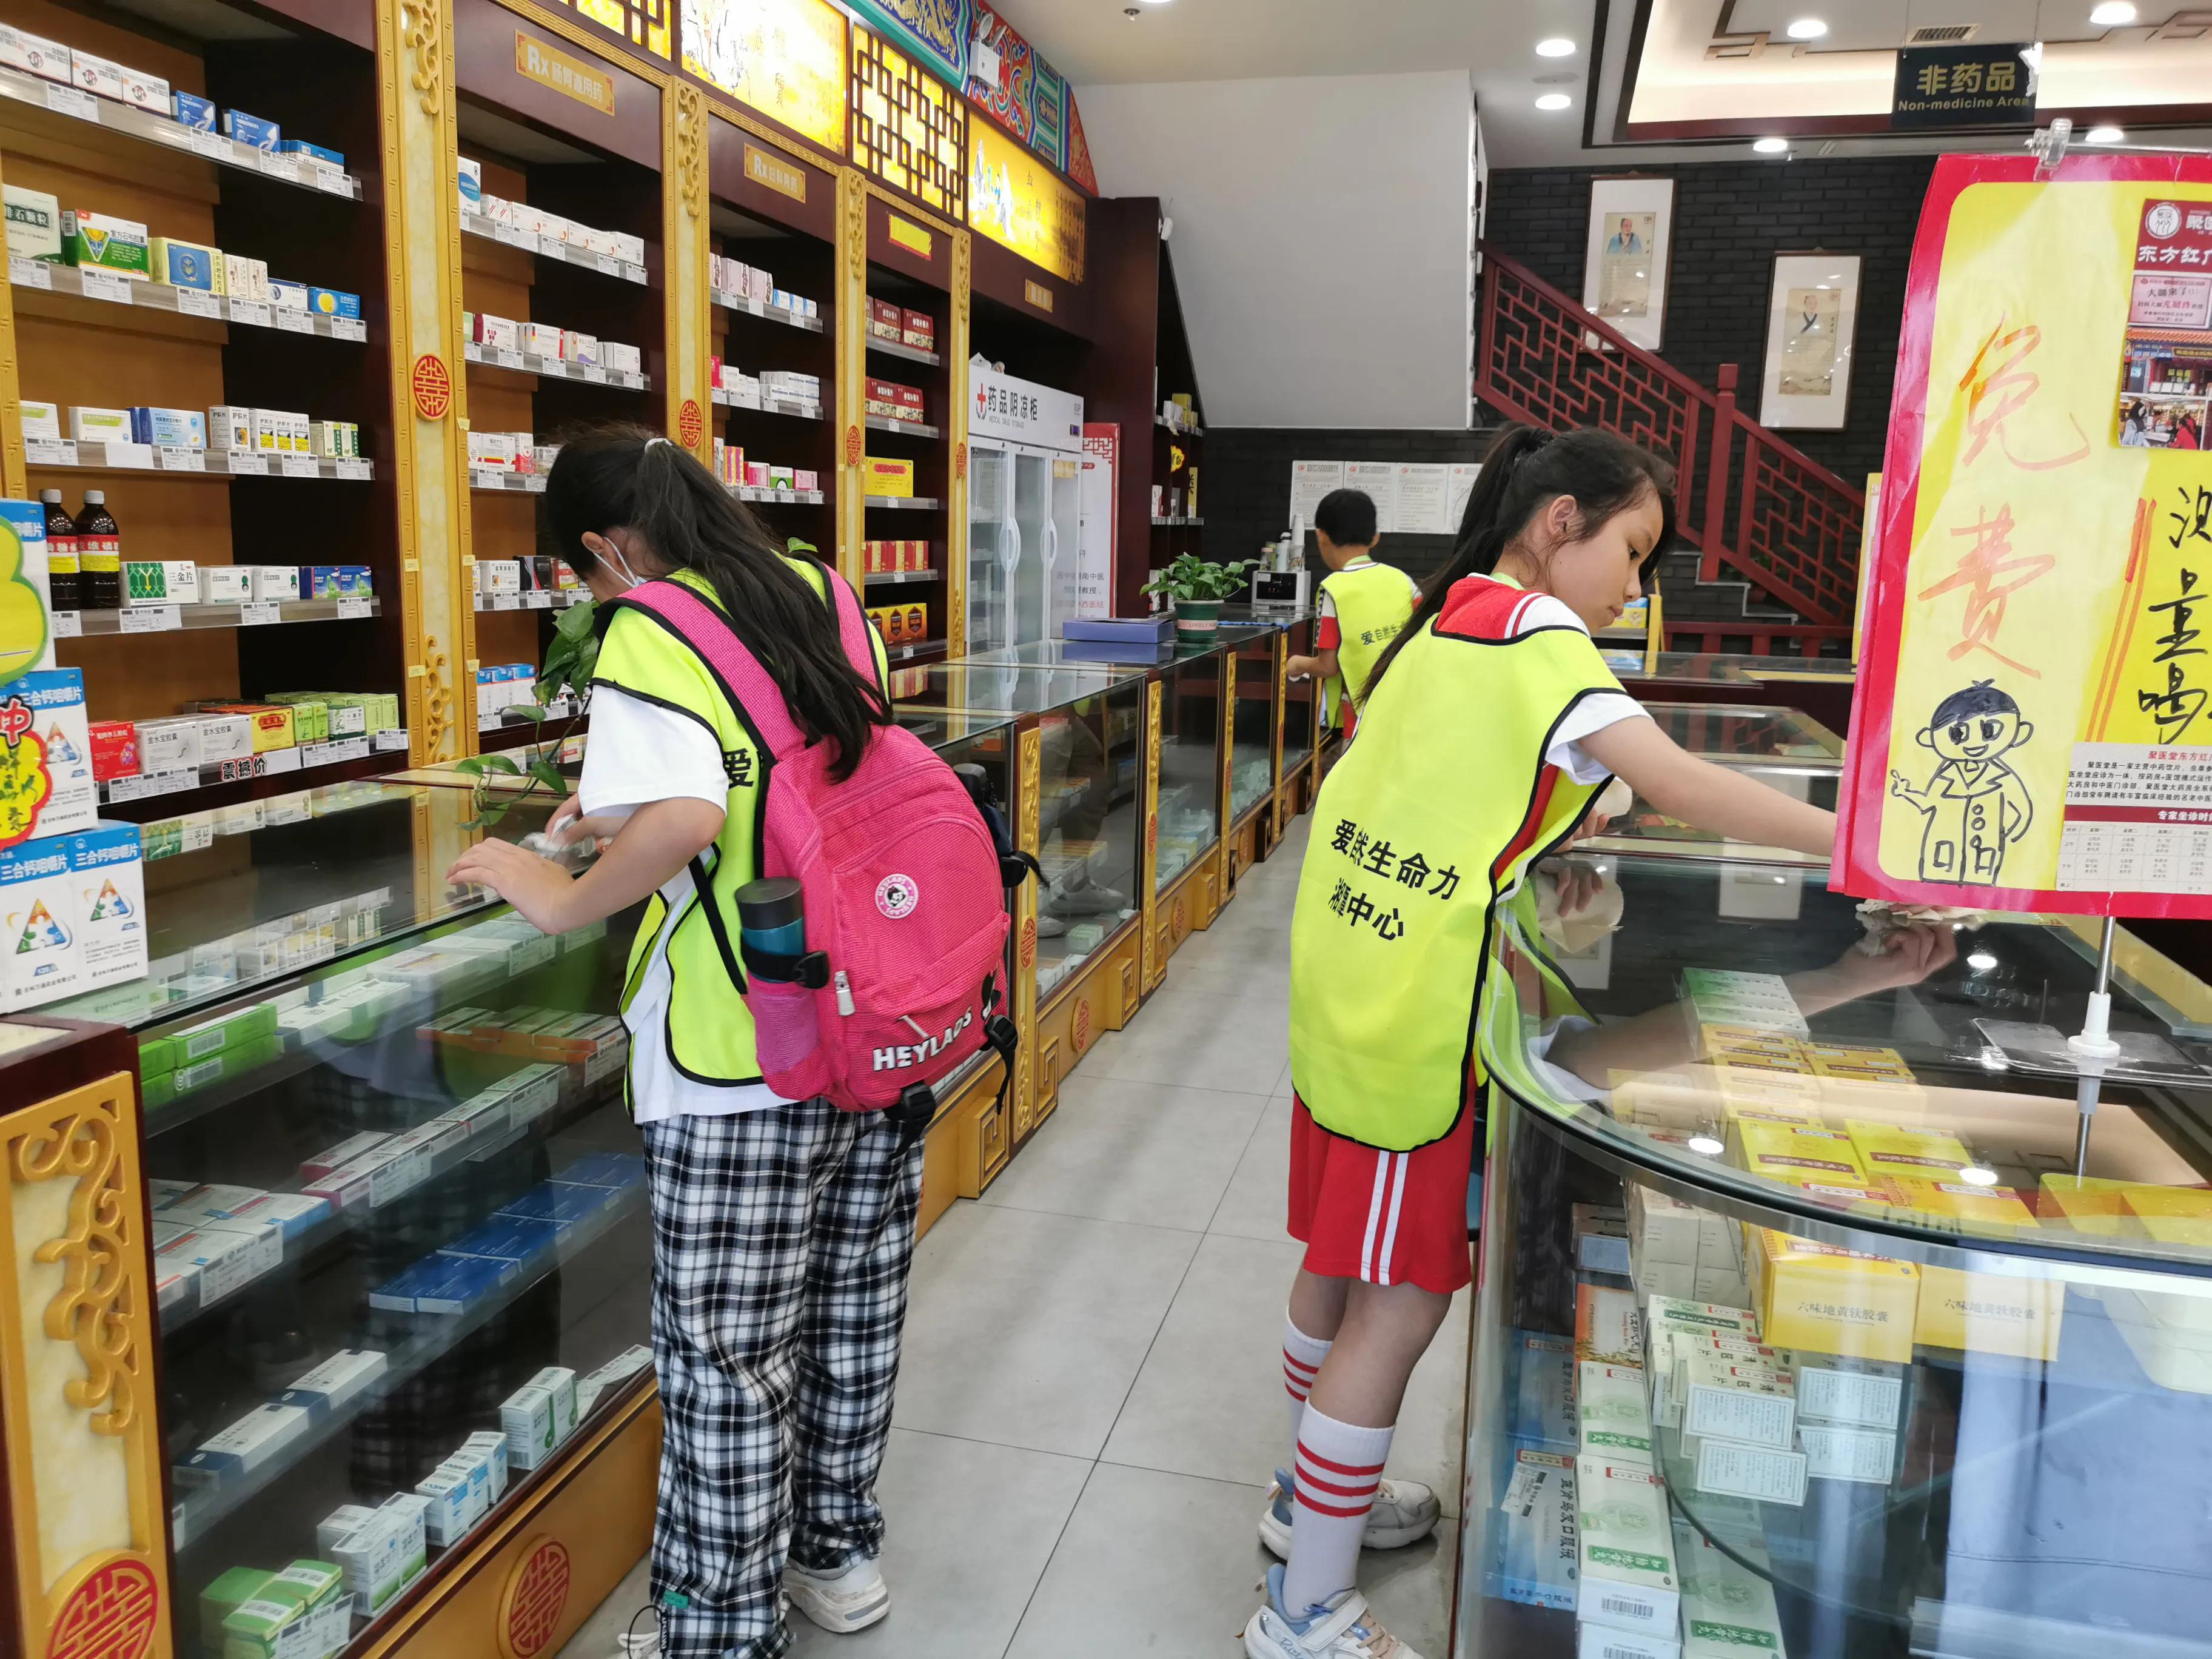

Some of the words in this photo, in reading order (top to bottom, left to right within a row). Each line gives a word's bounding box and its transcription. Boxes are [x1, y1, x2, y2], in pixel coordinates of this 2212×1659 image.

[528, 44, 549, 78] Rx
[1916, 61, 2016, 96] 非药品
[1899, 97, 1993, 111] Non-medicine
[1997, 96, 2028, 107] Area
[988, 386, 1037, 421] 药品阴凉柜
[169, 572, 193, 581] 三金片
[147, 732, 178, 745] 金水宝胶囊
[203, 725, 232, 736] 金水宝胶囊
[222, 757, 267, 780] 震撼价
[76, 843, 139, 866] 三合钙咀嚼片
[1, 854, 67, 879] 三合钙咀嚼片
[873, 1005, 972, 1071] HEYLADS
[1797, 1301, 1889, 1323] 六味地黄软胶囊
[1945, 1298, 2036, 1321] 六味地黄软胶囊
